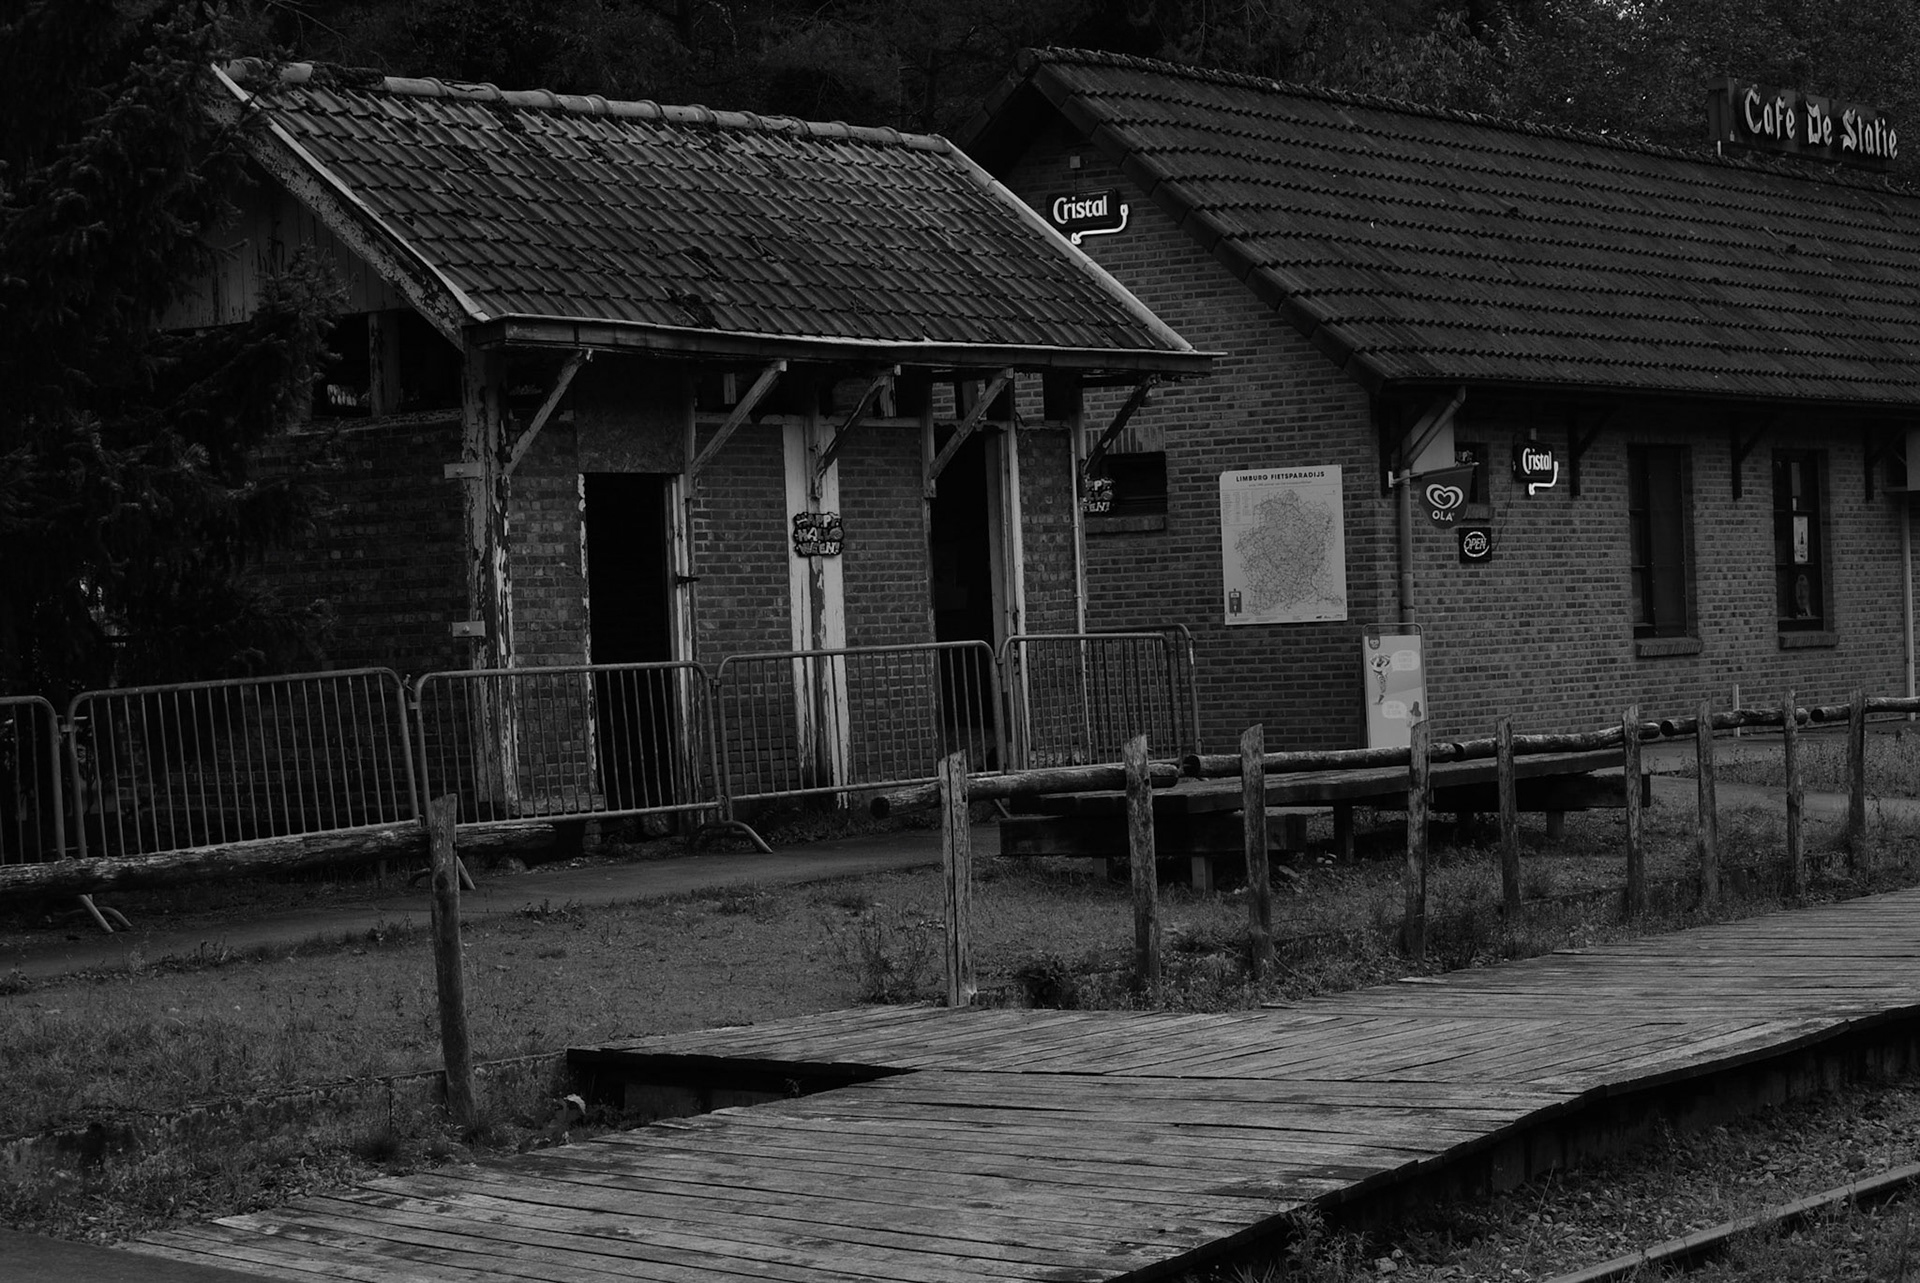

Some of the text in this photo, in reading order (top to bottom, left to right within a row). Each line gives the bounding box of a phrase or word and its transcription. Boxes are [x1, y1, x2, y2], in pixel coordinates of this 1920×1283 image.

[1744, 88, 1796, 140] Cafe
[1840, 108, 1899, 160] Statie
[1052, 194, 1109, 225] Cristal
[1521, 447, 1553, 475] Cristal
[1236, 471, 1325, 482] LIMBURG FIETSPARADIJS
[1432, 509, 1454, 522] OLA
[1464, 537, 1487, 551] OPEN
